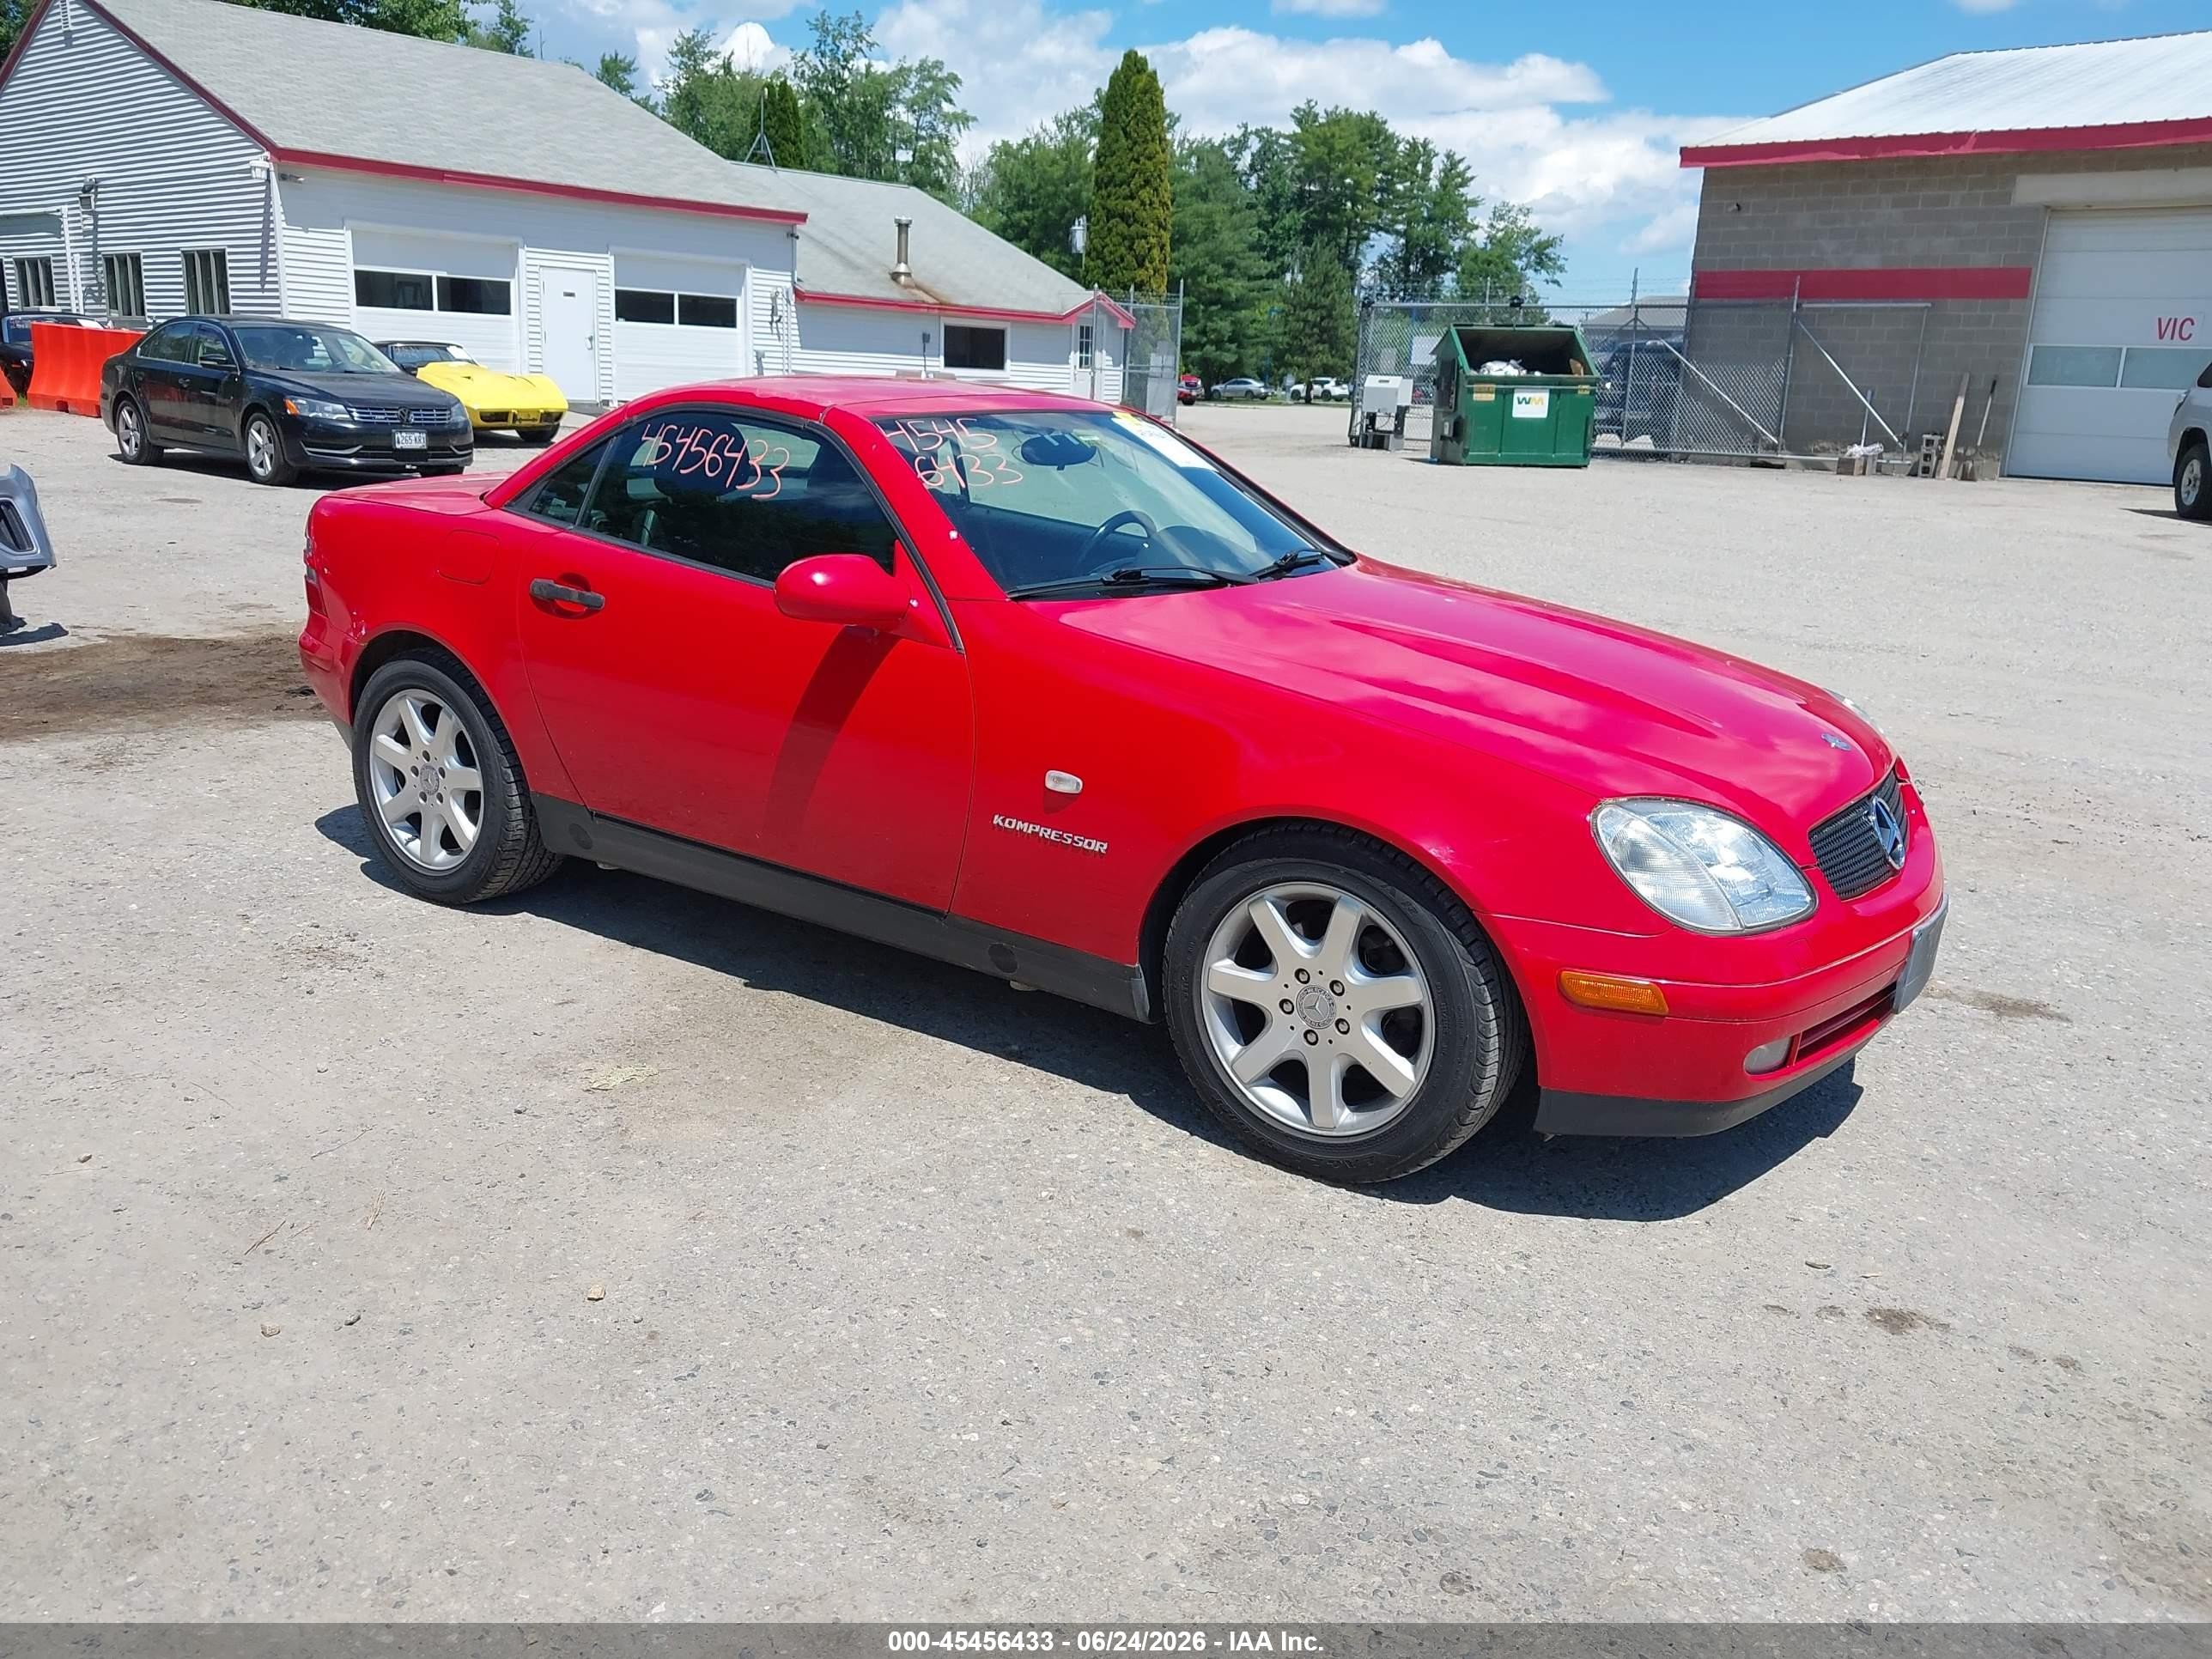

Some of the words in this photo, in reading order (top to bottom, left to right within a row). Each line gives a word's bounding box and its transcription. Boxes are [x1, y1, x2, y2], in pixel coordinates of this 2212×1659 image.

[2158, 317, 2195, 341] VIC
[1516, 396, 1544, 405] WM
[875, 418, 998, 453] 4545
[641, 422, 790, 499] 45456433
[915, 453, 1024, 489] 6433
[992, 814, 1108, 854] KOMPRESSOR
